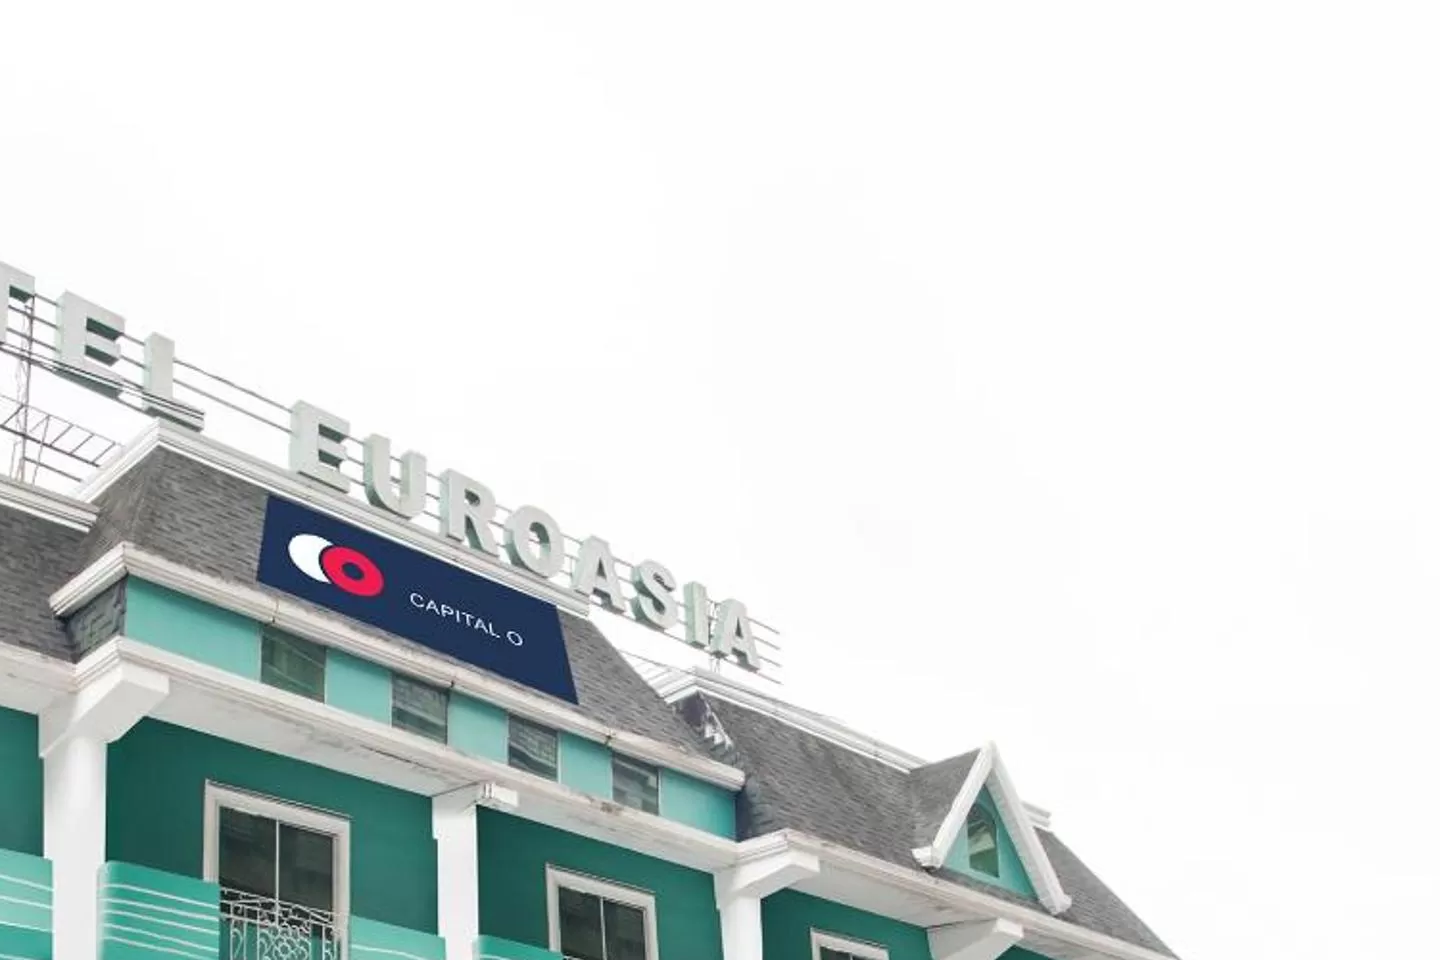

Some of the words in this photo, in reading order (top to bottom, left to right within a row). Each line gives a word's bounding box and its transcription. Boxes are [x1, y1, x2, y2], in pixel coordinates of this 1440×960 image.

[289, 399, 762, 673] EUROASIA
[409, 592, 501, 638] CAPITAL
[506, 630, 524, 646] O
